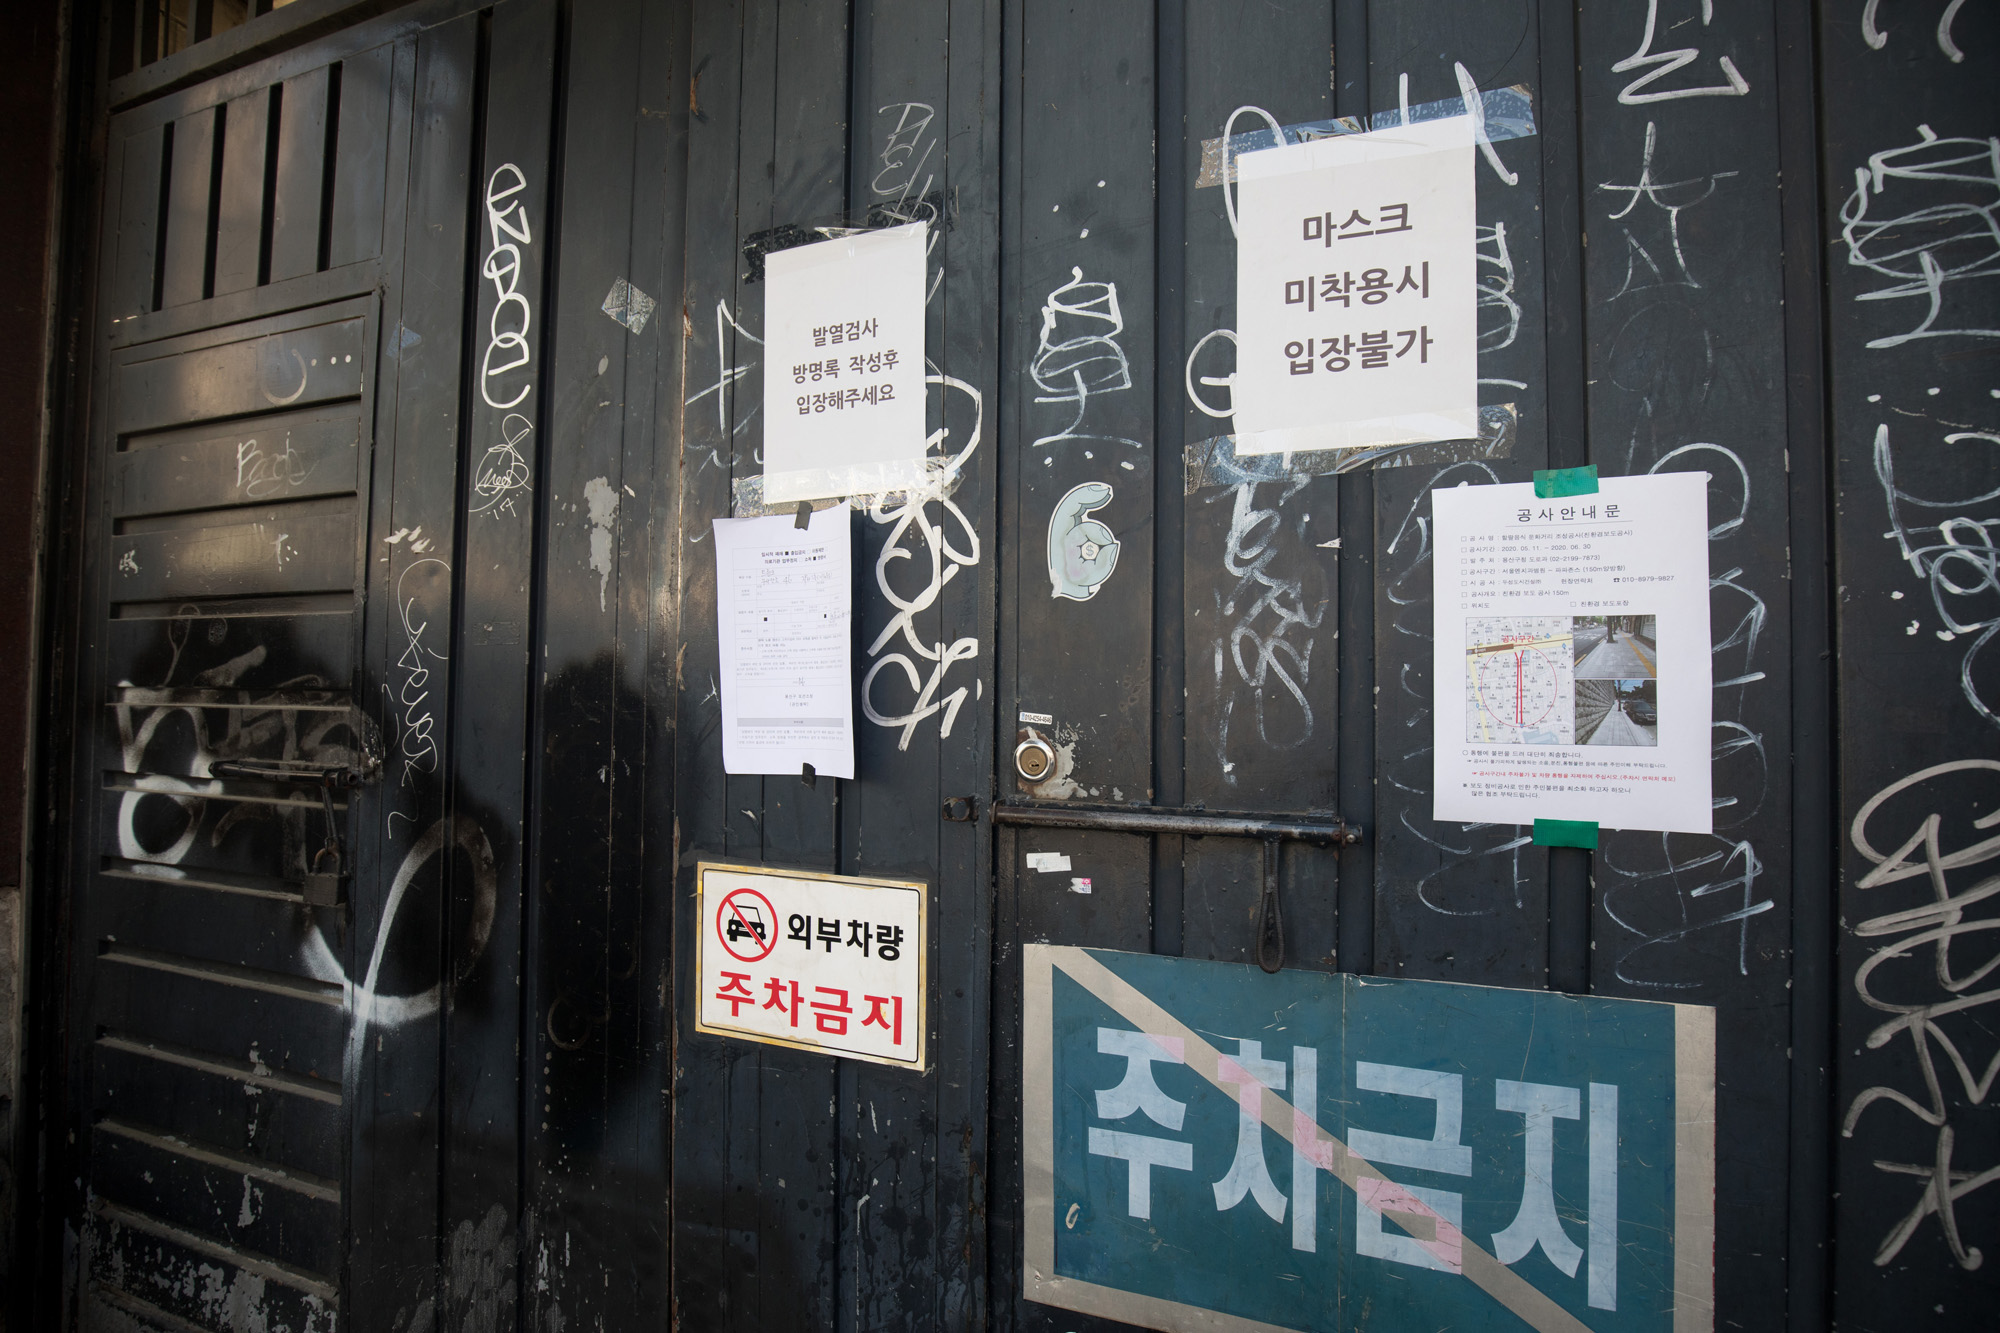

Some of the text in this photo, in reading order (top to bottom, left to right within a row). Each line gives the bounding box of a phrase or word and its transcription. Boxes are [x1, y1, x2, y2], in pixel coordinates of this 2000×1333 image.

[1303, 203, 1413, 248] 마스크
[1285, 261, 1429, 312] 미착용시
[813, 318, 878, 347] 발열검사
[1284, 326, 1433, 375] 입장불가
[793, 350, 899, 384] 방명록 작성후
[797, 384, 895, 415] 입장해주세요
[1517, 505, 1621, 522] 공사안내문
[1503, 635, 1534, 643] 공사구간
[788, 914, 903, 961] 외부차량
[716, 971, 903, 1045] 주차금지
[1088, 1027, 1618, 1311] 주차금지
